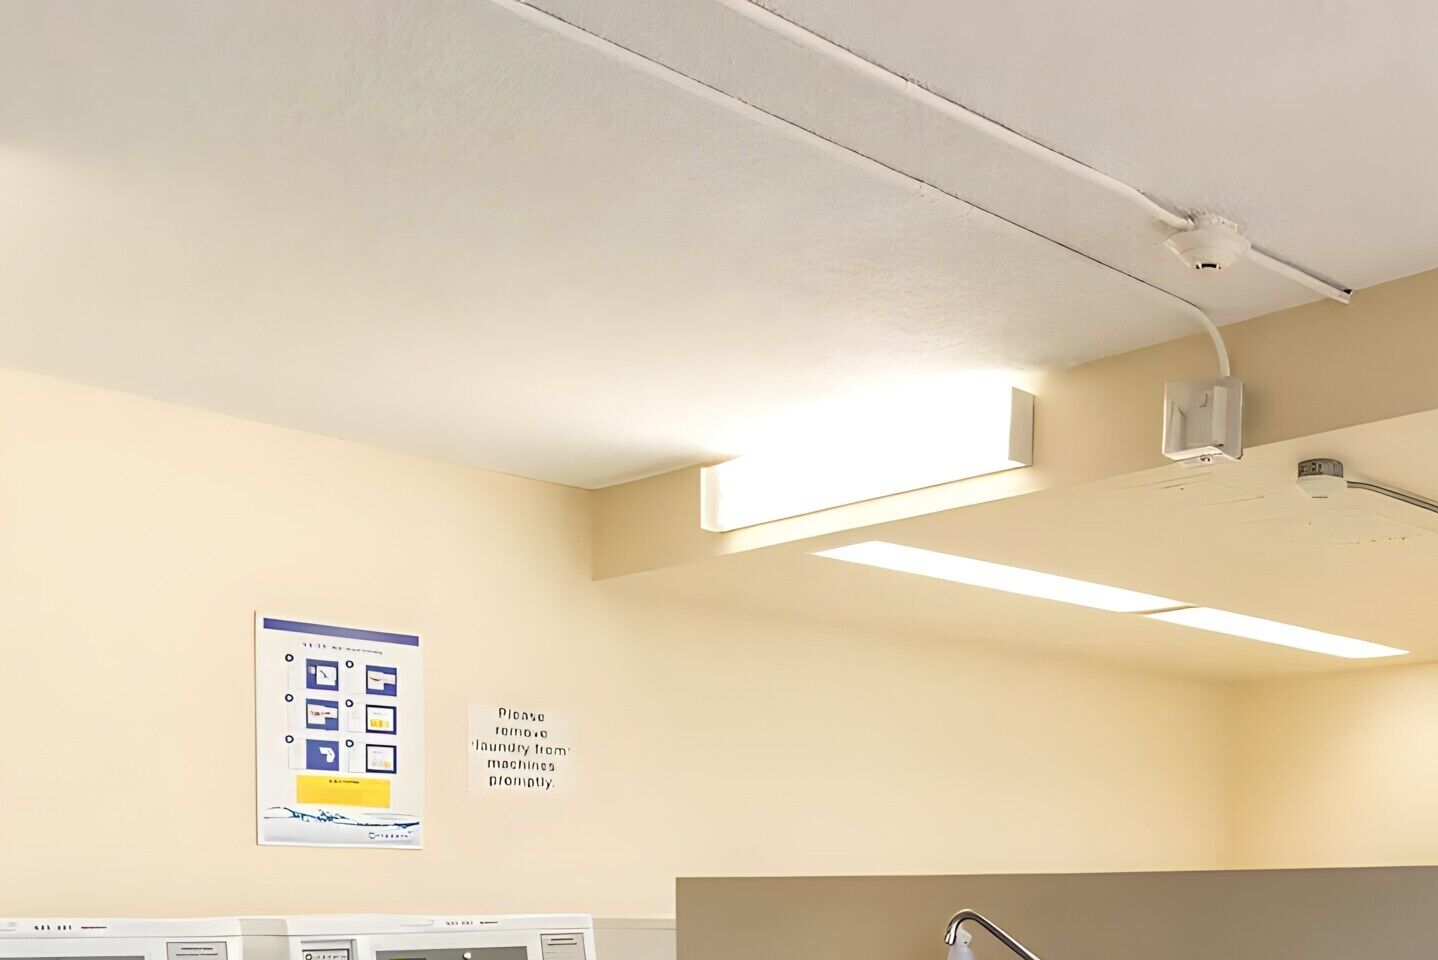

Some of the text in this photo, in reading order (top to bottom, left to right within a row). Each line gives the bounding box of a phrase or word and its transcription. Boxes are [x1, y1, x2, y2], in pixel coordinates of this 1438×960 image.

[498, 707, 545, 722] Please
[495, 726, 548, 739] remove
[535, 743, 567, 756] from
[487, 759, 555, 772] machines
